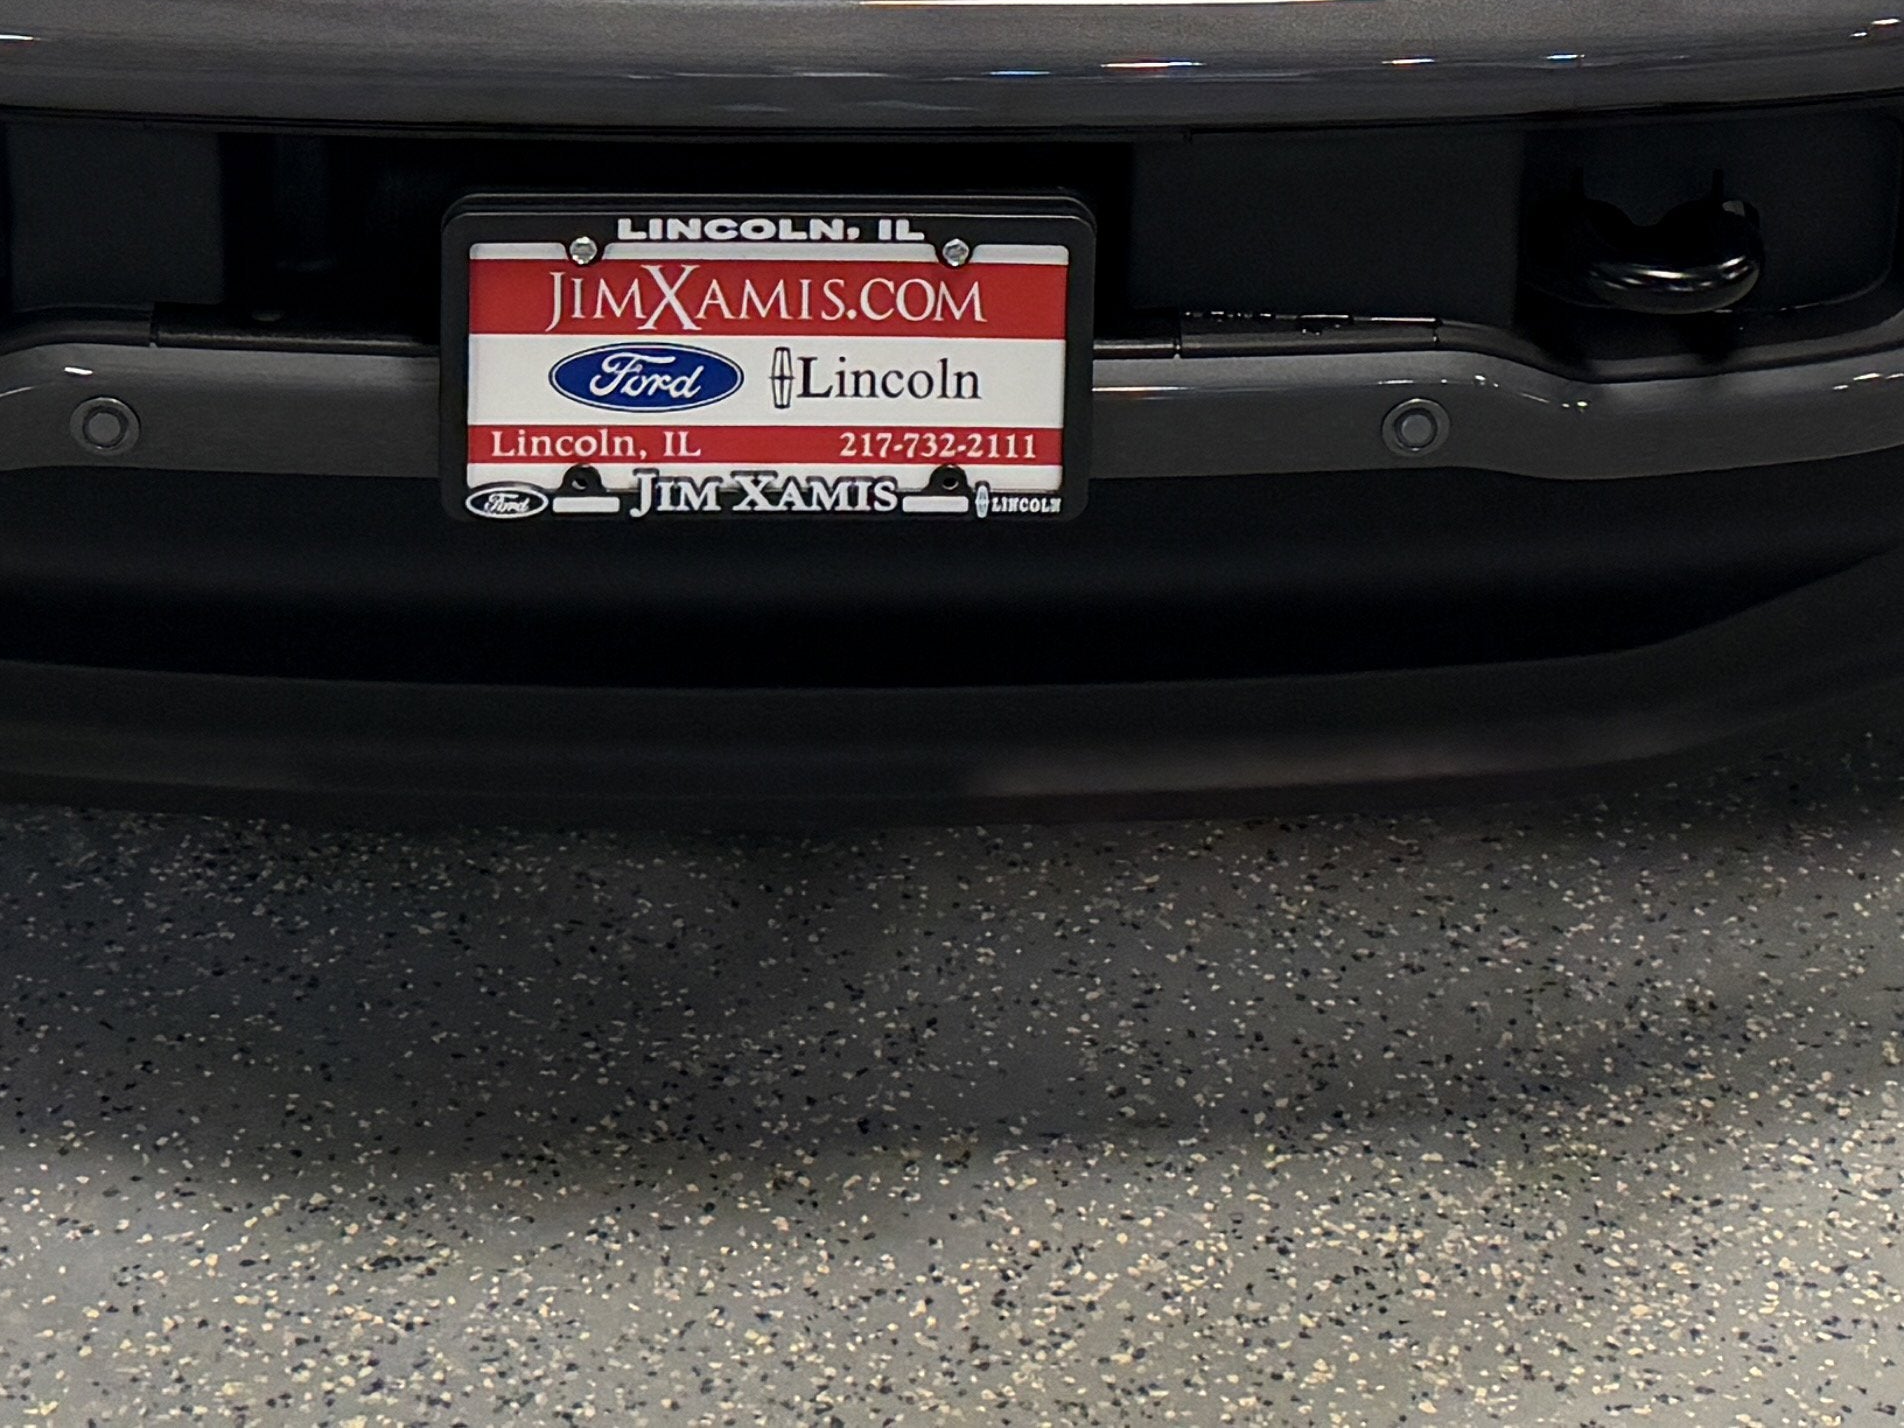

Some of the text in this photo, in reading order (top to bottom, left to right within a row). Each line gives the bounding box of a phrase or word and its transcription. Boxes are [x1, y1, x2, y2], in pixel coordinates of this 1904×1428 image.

[617, 217, 925, 241] LINCOLN, IL
[587, 350, 705, 401] Ford
[796, 356, 982, 400] Lincoln
[490, 428, 702, 460] Lincoln, IL
[839, 431, 1038, 459] 217-732-2111
[991, 496, 1062, 514] LINCOLN
